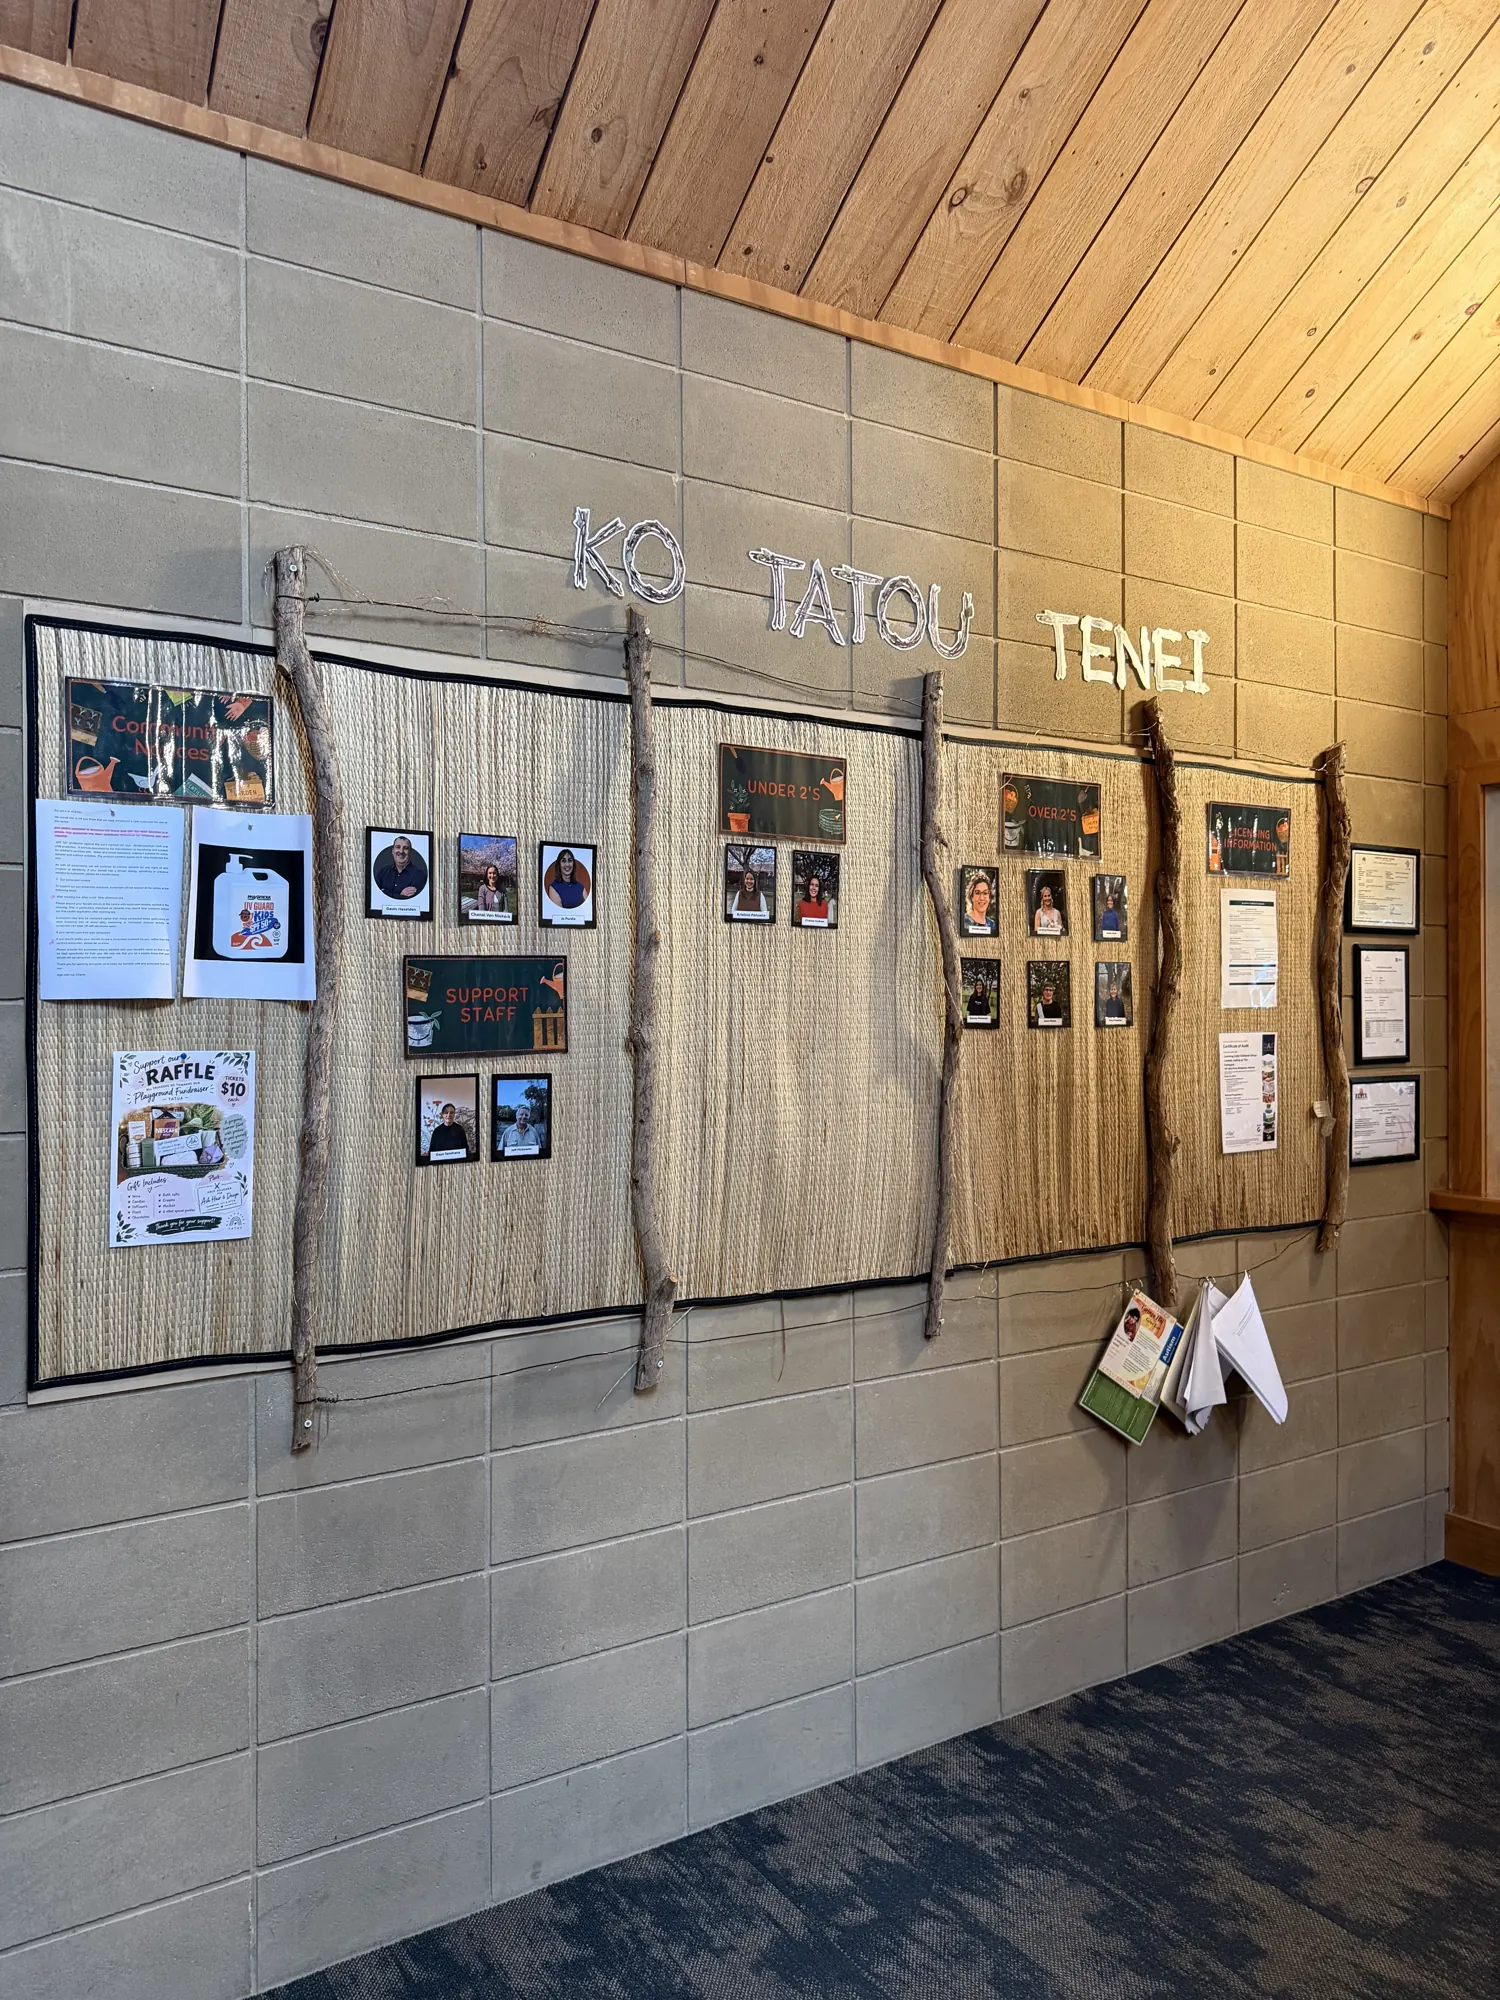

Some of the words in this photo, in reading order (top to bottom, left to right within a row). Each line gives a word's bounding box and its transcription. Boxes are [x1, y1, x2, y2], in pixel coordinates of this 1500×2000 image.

[573, 506, 687, 604] KO
[748, 547, 975, 660] TATOU
[1035, 609, 1211, 696] TENEI
[747, 779, 796, 799] UNDER
[799, 785, 821, 801] 2'S
[1028, 805, 1058, 820] OVER
[1060, 808, 1078, 822] 2'S
[1223, 838, 1278, 852] INFORMATION
[244, 902, 253, 911] UV
[253, 902, 275, 911] GUARD
[249, 921, 260, 933] SPF
[445, 987, 529, 1004] SUPPORT
[460, 1006, 517, 1023] STAFF
[133, 1055, 165, 1075] Support
[167, 1054, 181, 1064] our
[145, 1062, 216, 1086] RAFFLE
[132, 1087, 174, 1105] Playground
[175, 1085, 210, 1097] Fundraiser
[221, 1081, 246, 1097] $10
[126, 1181, 141, 1191] Gift
[155, 1221, 169, 1231] Thank
[1162, 1335, 1177, 1362] Autism
